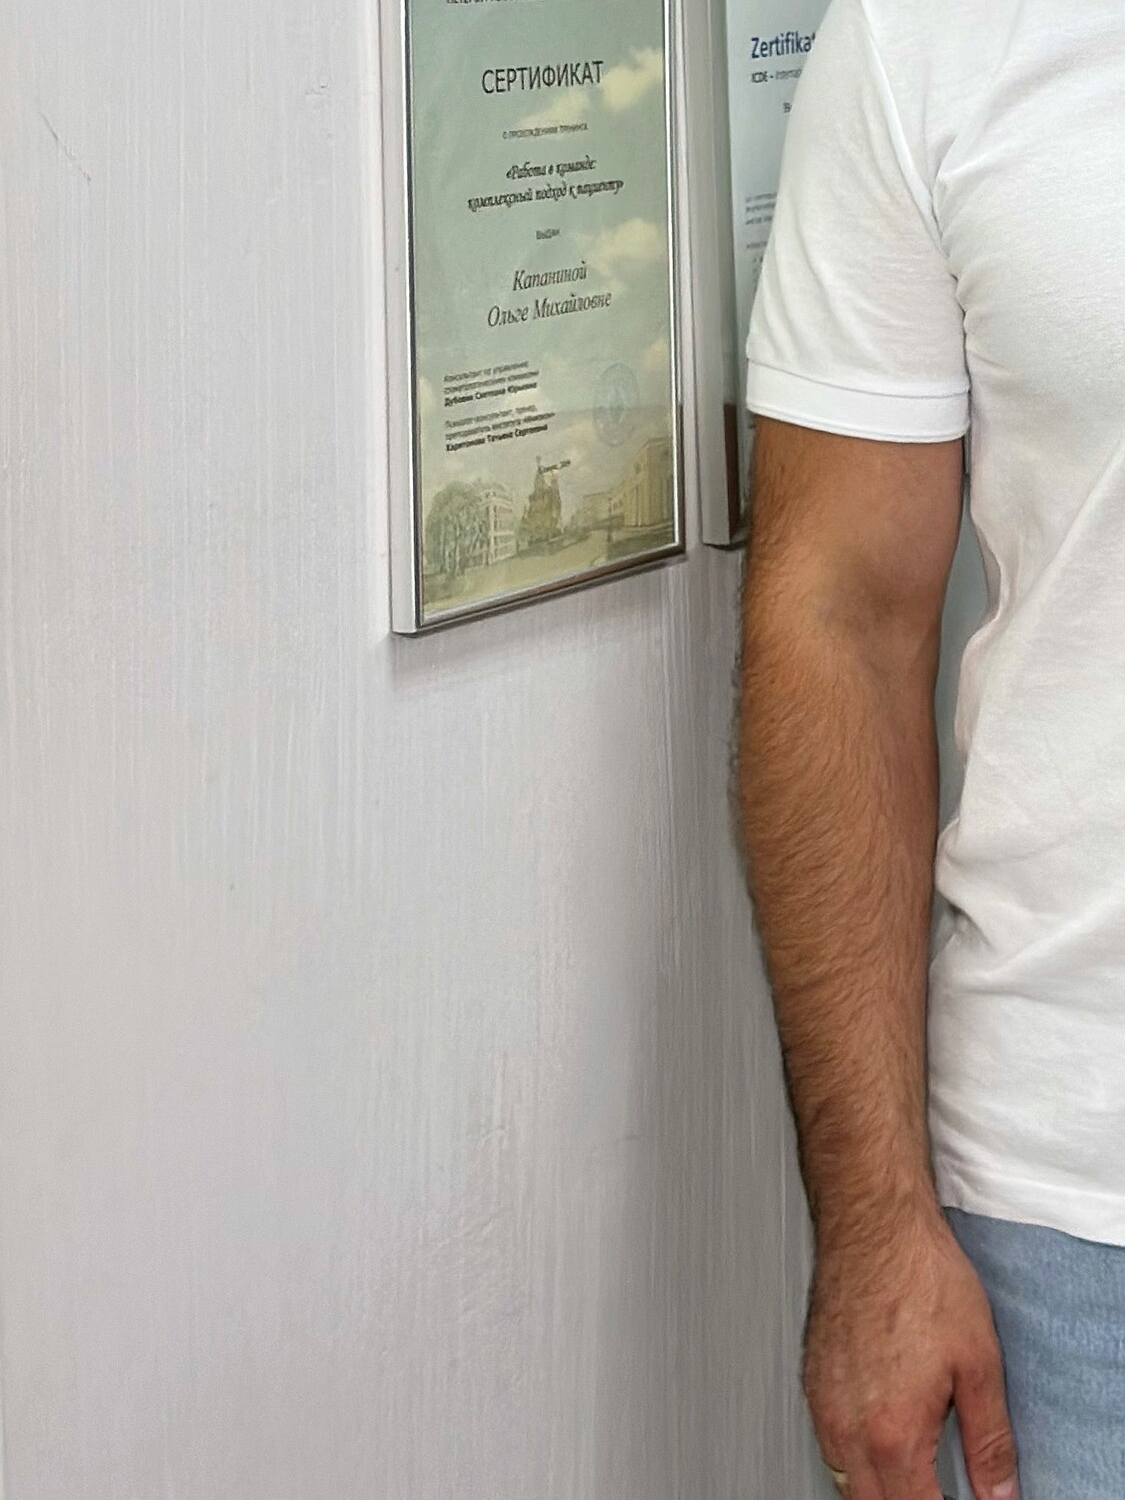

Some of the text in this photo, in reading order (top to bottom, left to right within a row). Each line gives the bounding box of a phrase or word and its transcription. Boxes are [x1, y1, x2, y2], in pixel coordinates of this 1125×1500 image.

[481, 60, 604, 95] СЕРТИФИКАТ
[512, 258, 589, 293] Капаниной
[487, 290, 613, 328] Ольге Михайловне
